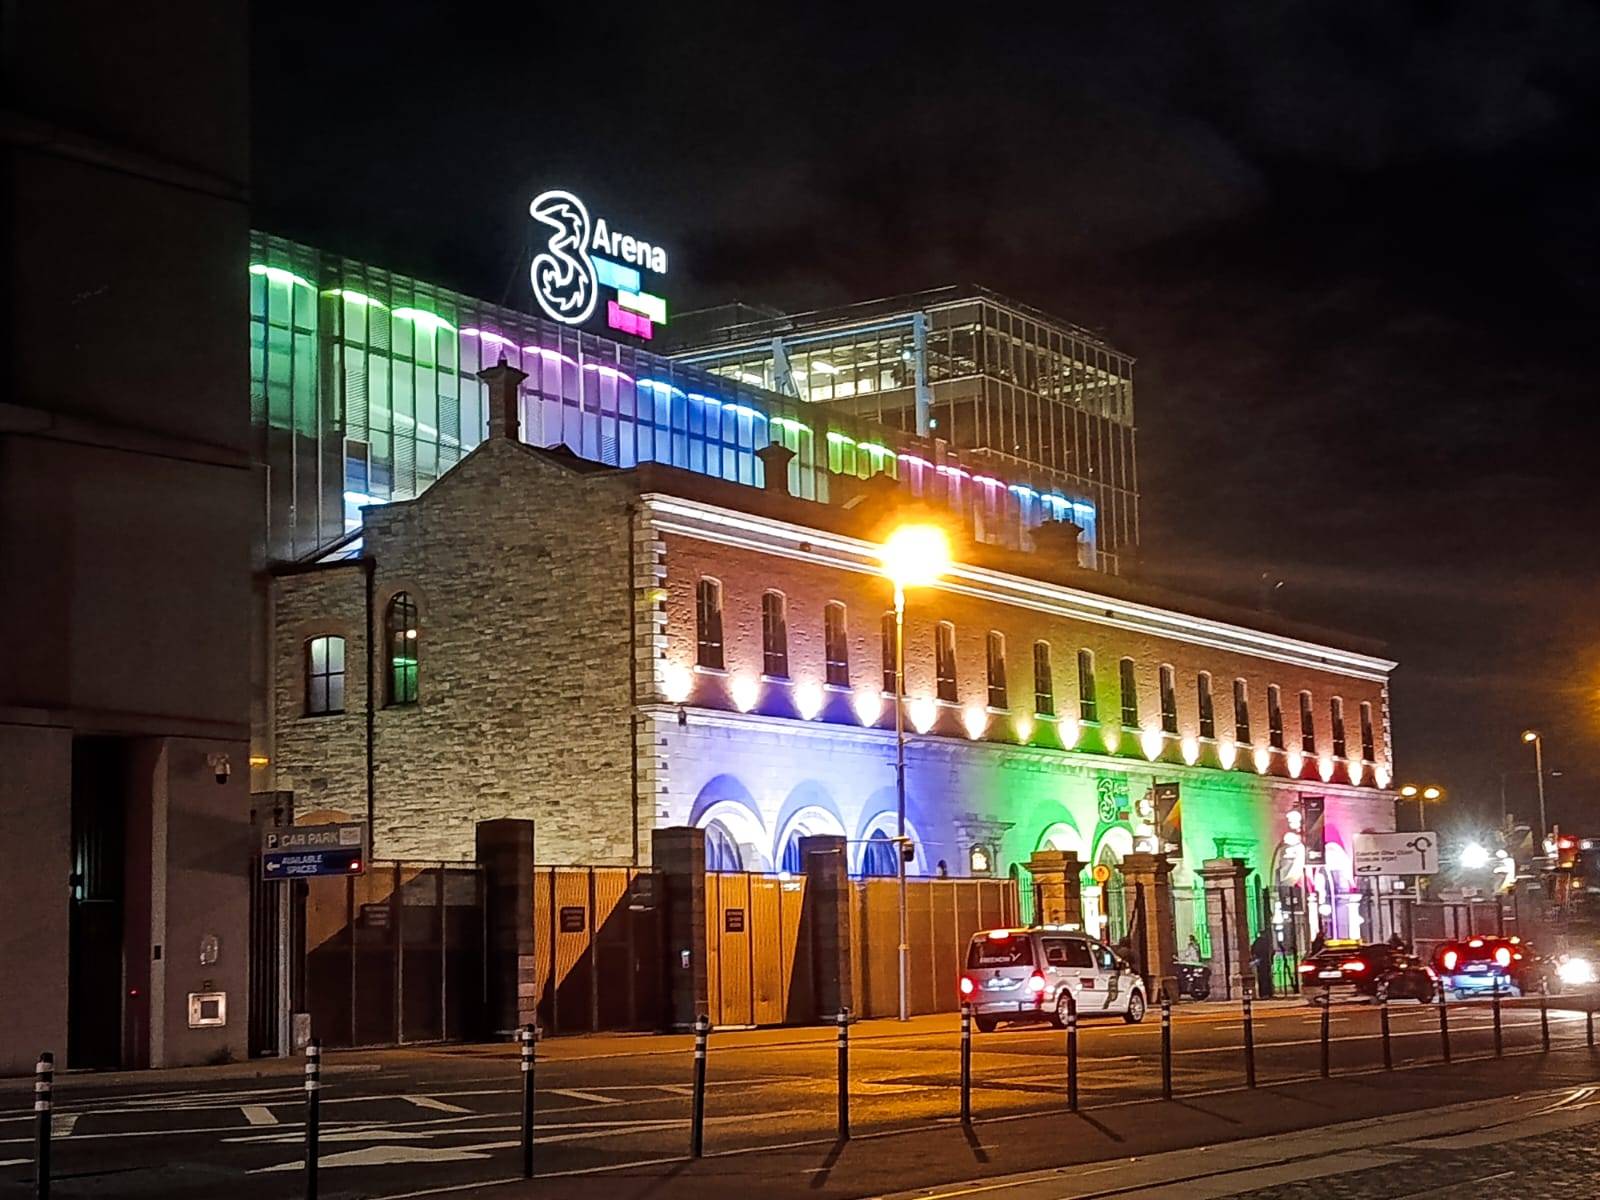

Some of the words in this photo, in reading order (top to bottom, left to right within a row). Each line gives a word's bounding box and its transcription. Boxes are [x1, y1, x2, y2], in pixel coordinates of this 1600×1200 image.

[592, 218, 667, 274] Arena
[268, 834, 277, 848] P
[281, 834, 305, 847] CAR
[308, 832, 338, 845] PARK
[282, 855, 323, 864] AVAILABLE
[287, 865, 317, 874] SPACES
